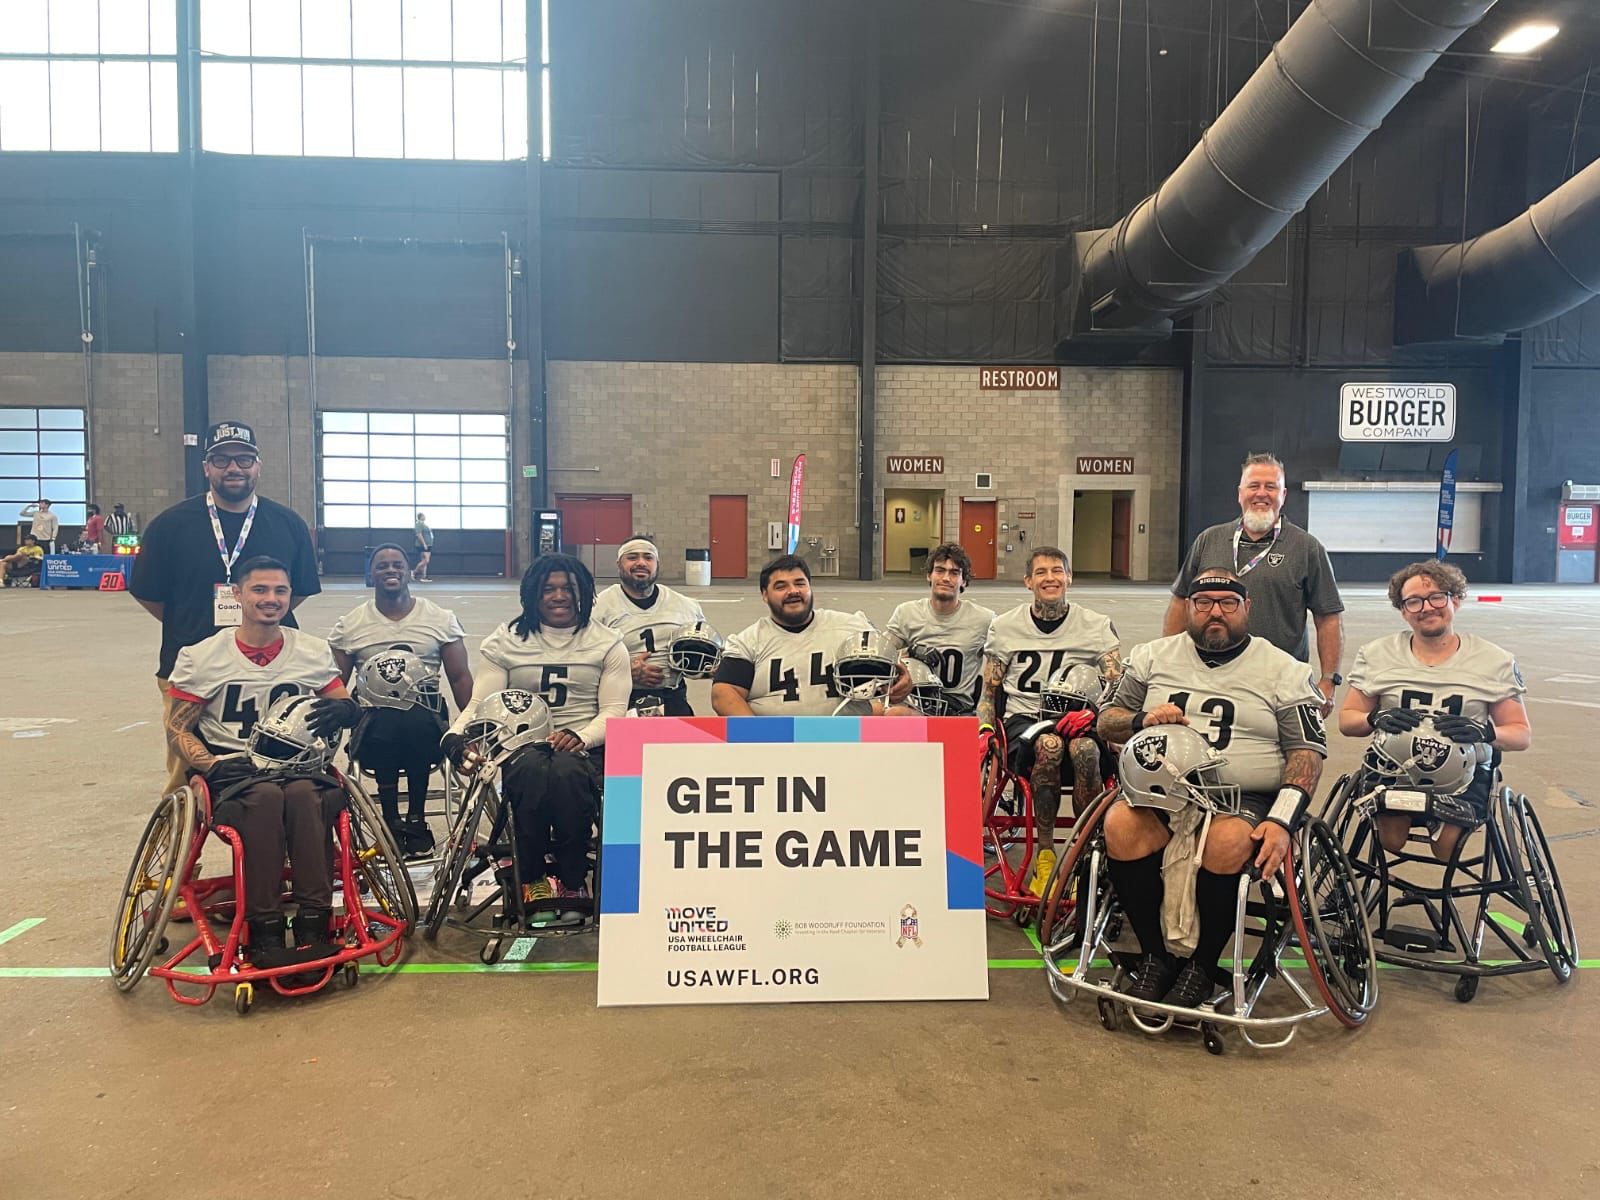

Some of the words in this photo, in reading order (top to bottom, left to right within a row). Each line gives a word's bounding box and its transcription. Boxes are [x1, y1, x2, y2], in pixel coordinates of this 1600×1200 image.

[982, 370, 1058, 387] RESTROOM
[1352, 388, 1446, 399] WESTWORLD
[1349, 400, 1446, 426] BURGER
[1362, 427, 1431, 438] COMPANY
[889, 459, 942, 473] WOMEN
[1079, 460, 1132, 473] WOMEN
[1567, 512, 1591, 521] BURGER
[101, 574, 119, 589] 30
[639, 628, 656, 653] 1
[769, 652, 840, 702] 44
[538, 665, 569, 707] 5
[1167, 692, 1236, 751] 13
[667, 776, 764, 815] GET
[777, 776, 826, 813] IN
[665, 831, 763, 869] THE
[775, 829, 922, 868] GAME
[665, 907, 716, 919] MOVE
[669, 920, 728, 933] UNITED
[844, 921, 886, 929] FOUNDATION
[902, 927, 917, 936] NFL
[688, 935, 743, 943] WHEELCHAIR
[668, 944, 712, 952] FOOTBALL
[713, 943, 747, 951] LEAGUE
[667, 968, 820, 987] USAWFL.ORG
